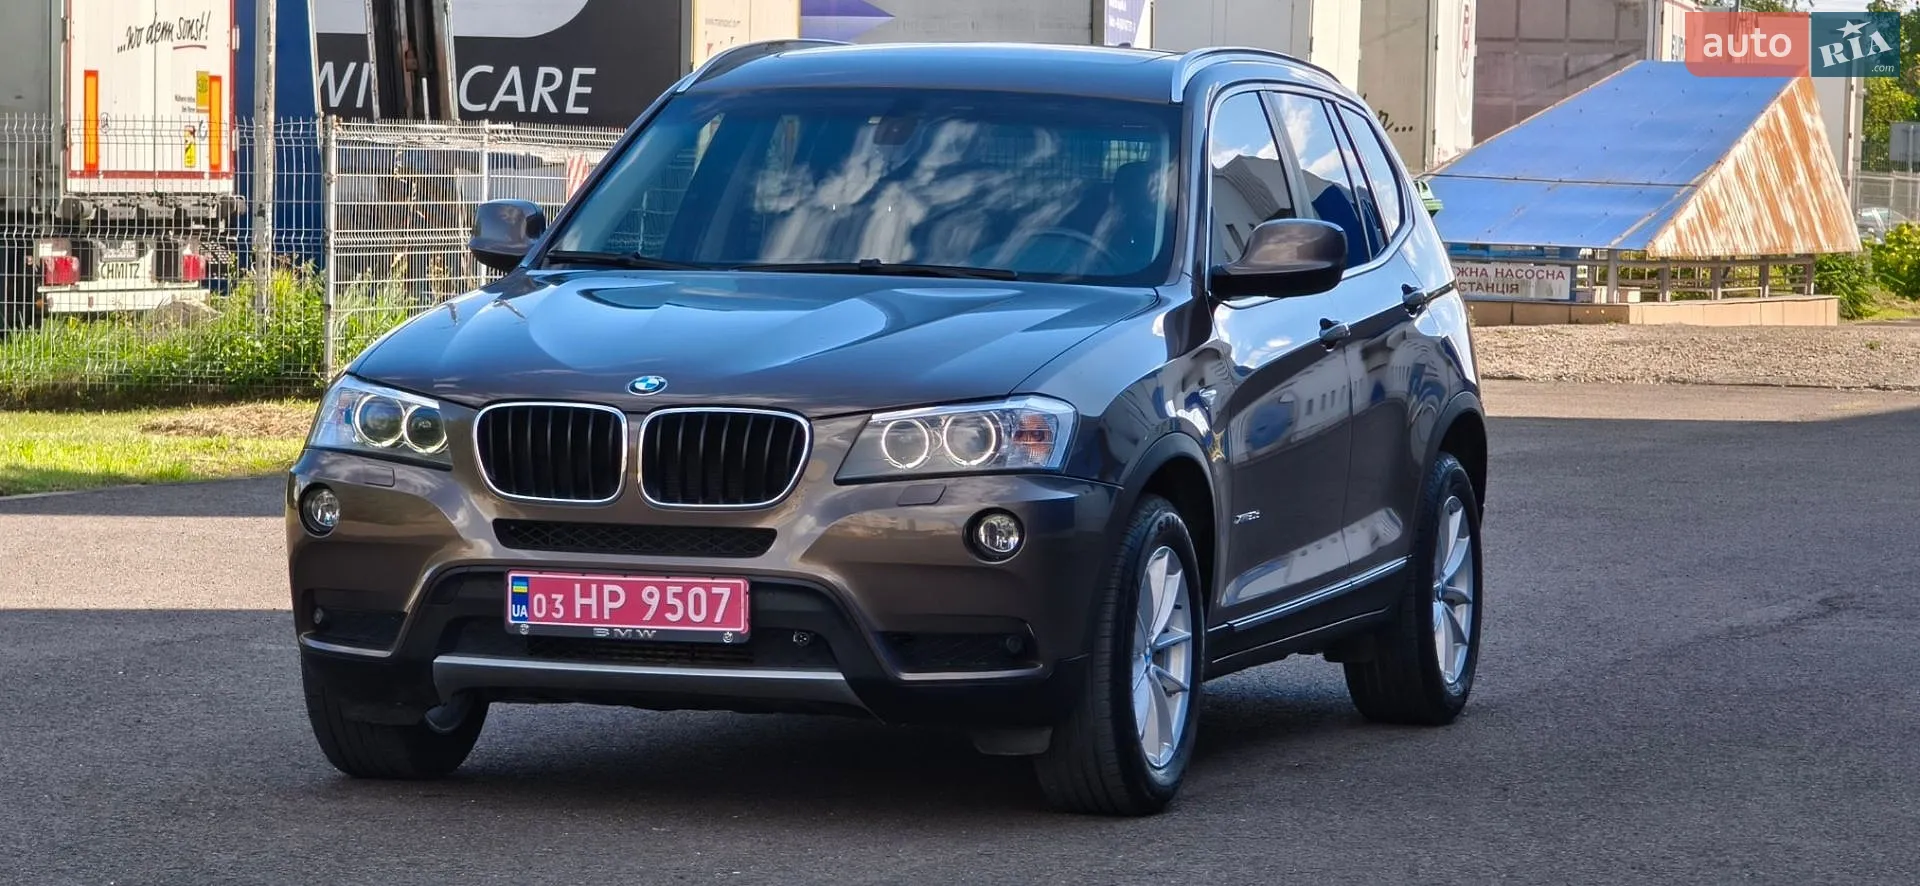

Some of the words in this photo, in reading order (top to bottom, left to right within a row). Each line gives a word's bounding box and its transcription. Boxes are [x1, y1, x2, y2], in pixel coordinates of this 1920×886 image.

[459, 65, 597, 114] CARE
[1495, 268, 1566, 280] НАСОСНА
[1458, 281, 1519, 295] СТАНЦІЯ
[512, 604, 528, 618] UA
[533, 593, 565, 619] 03
[574, 583, 626, 620] HP
[641, 586, 731, 624] 9507
[593, 627, 656, 639] BMW
